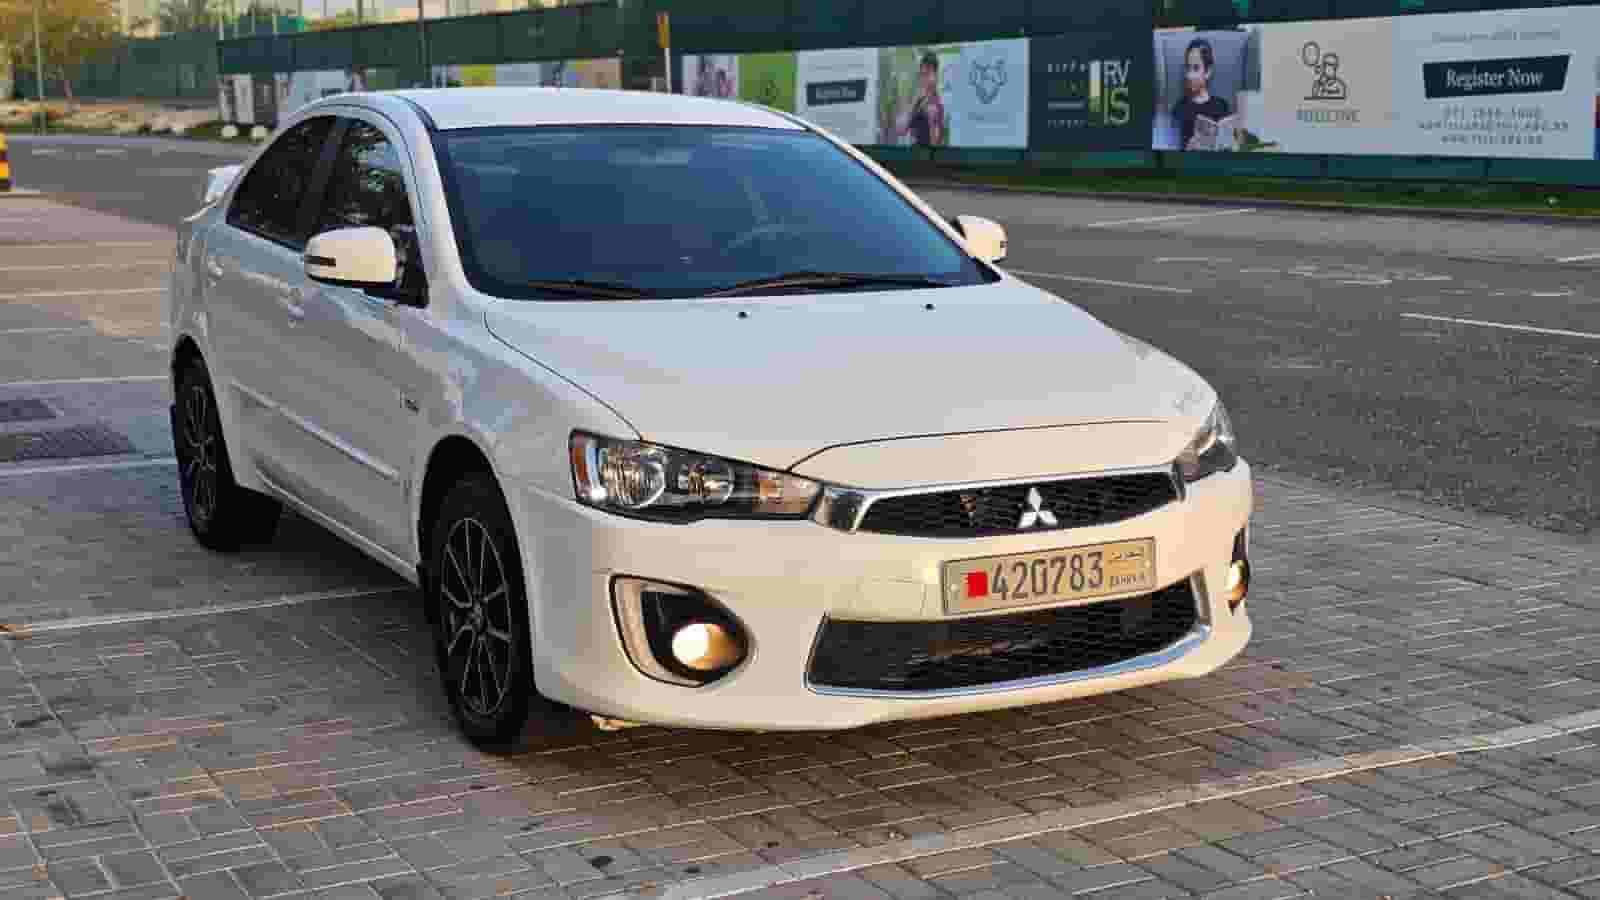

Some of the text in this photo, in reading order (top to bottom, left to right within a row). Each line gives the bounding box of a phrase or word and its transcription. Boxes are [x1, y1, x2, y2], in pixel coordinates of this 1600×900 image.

[1447, 65, 1543, 90] Register Now
[991, 551, 1103, 600] 420783
